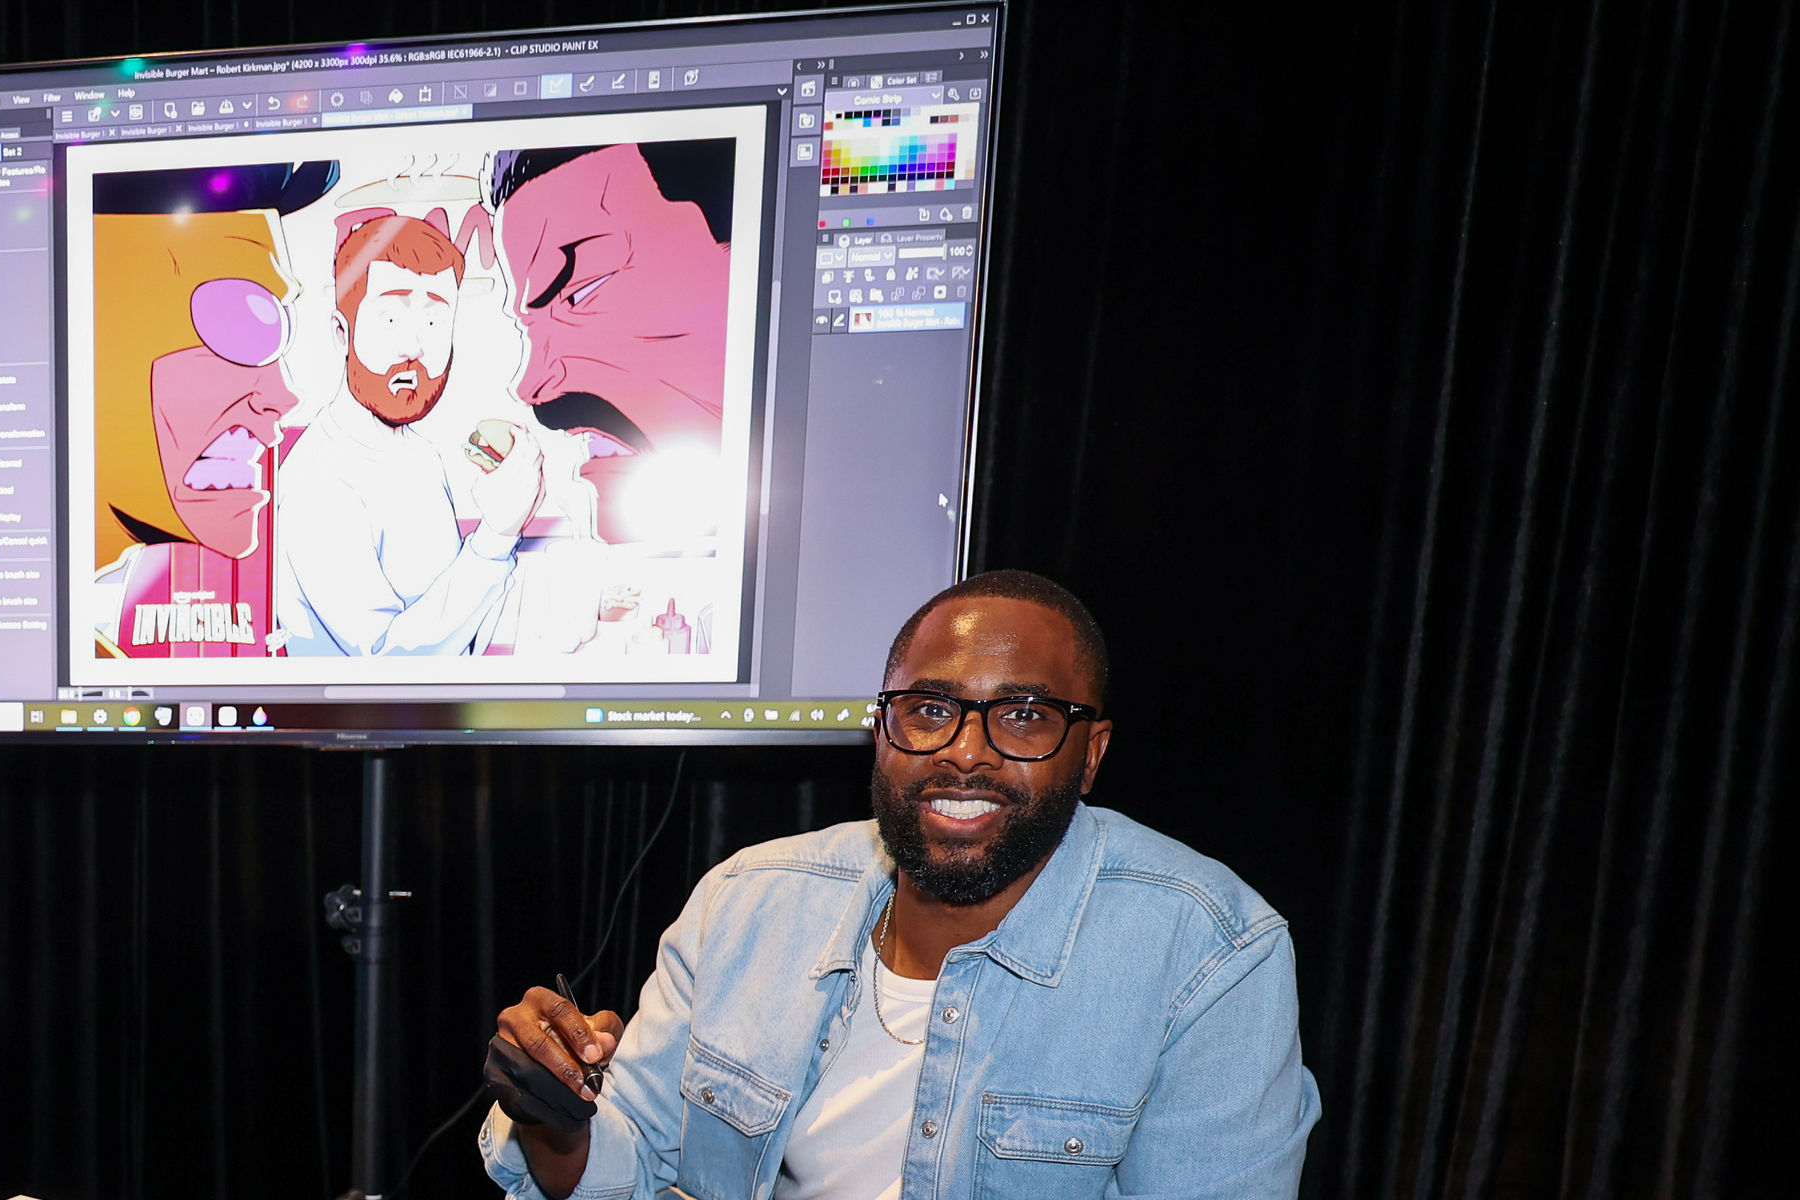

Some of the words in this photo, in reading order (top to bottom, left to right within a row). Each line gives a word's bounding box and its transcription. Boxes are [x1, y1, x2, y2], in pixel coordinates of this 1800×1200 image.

[134, 70, 164, 80] Invisible
[166, 69, 190, 79] Burger
[191, 67, 208, 76] Mart
[216, 65, 241, 74] Robert
[291, 59, 313, 71] (4200
[320, 58, 348, 70] 3300px
[350, 54, 377, 66] 300dpi
[378, 54, 402, 64] 35.6%
[510, 46, 528, 56] CLIP
[530, 42, 560, 54] STUDIO
[562, 41, 586, 52] PAINT
[588, 40, 599, 50] EX
[906, 76, 916, 85] Set
[12, 96, 30, 104] View
[44, 94, 62, 102] Filter
[74, 90, 105, 100] Window
[118, 88, 136, 98] Help
[188, 124, 214, 133] Invisible
[256, 120, 282, 129] Invisible
[55, 131, 80, 140] Invisible
[121, 128, 146, 137] Invisible
[854, 236, 872, 246] Layer
[897, 234, 913, 243] Layer
[914, 232, 943, 243] Property
[950, 247, 965, 256] 100
[131, 602, 256, 646] INVINCIBLE
[608, 710, 632, 722] Stock
[634, 710, 664, 722] market
